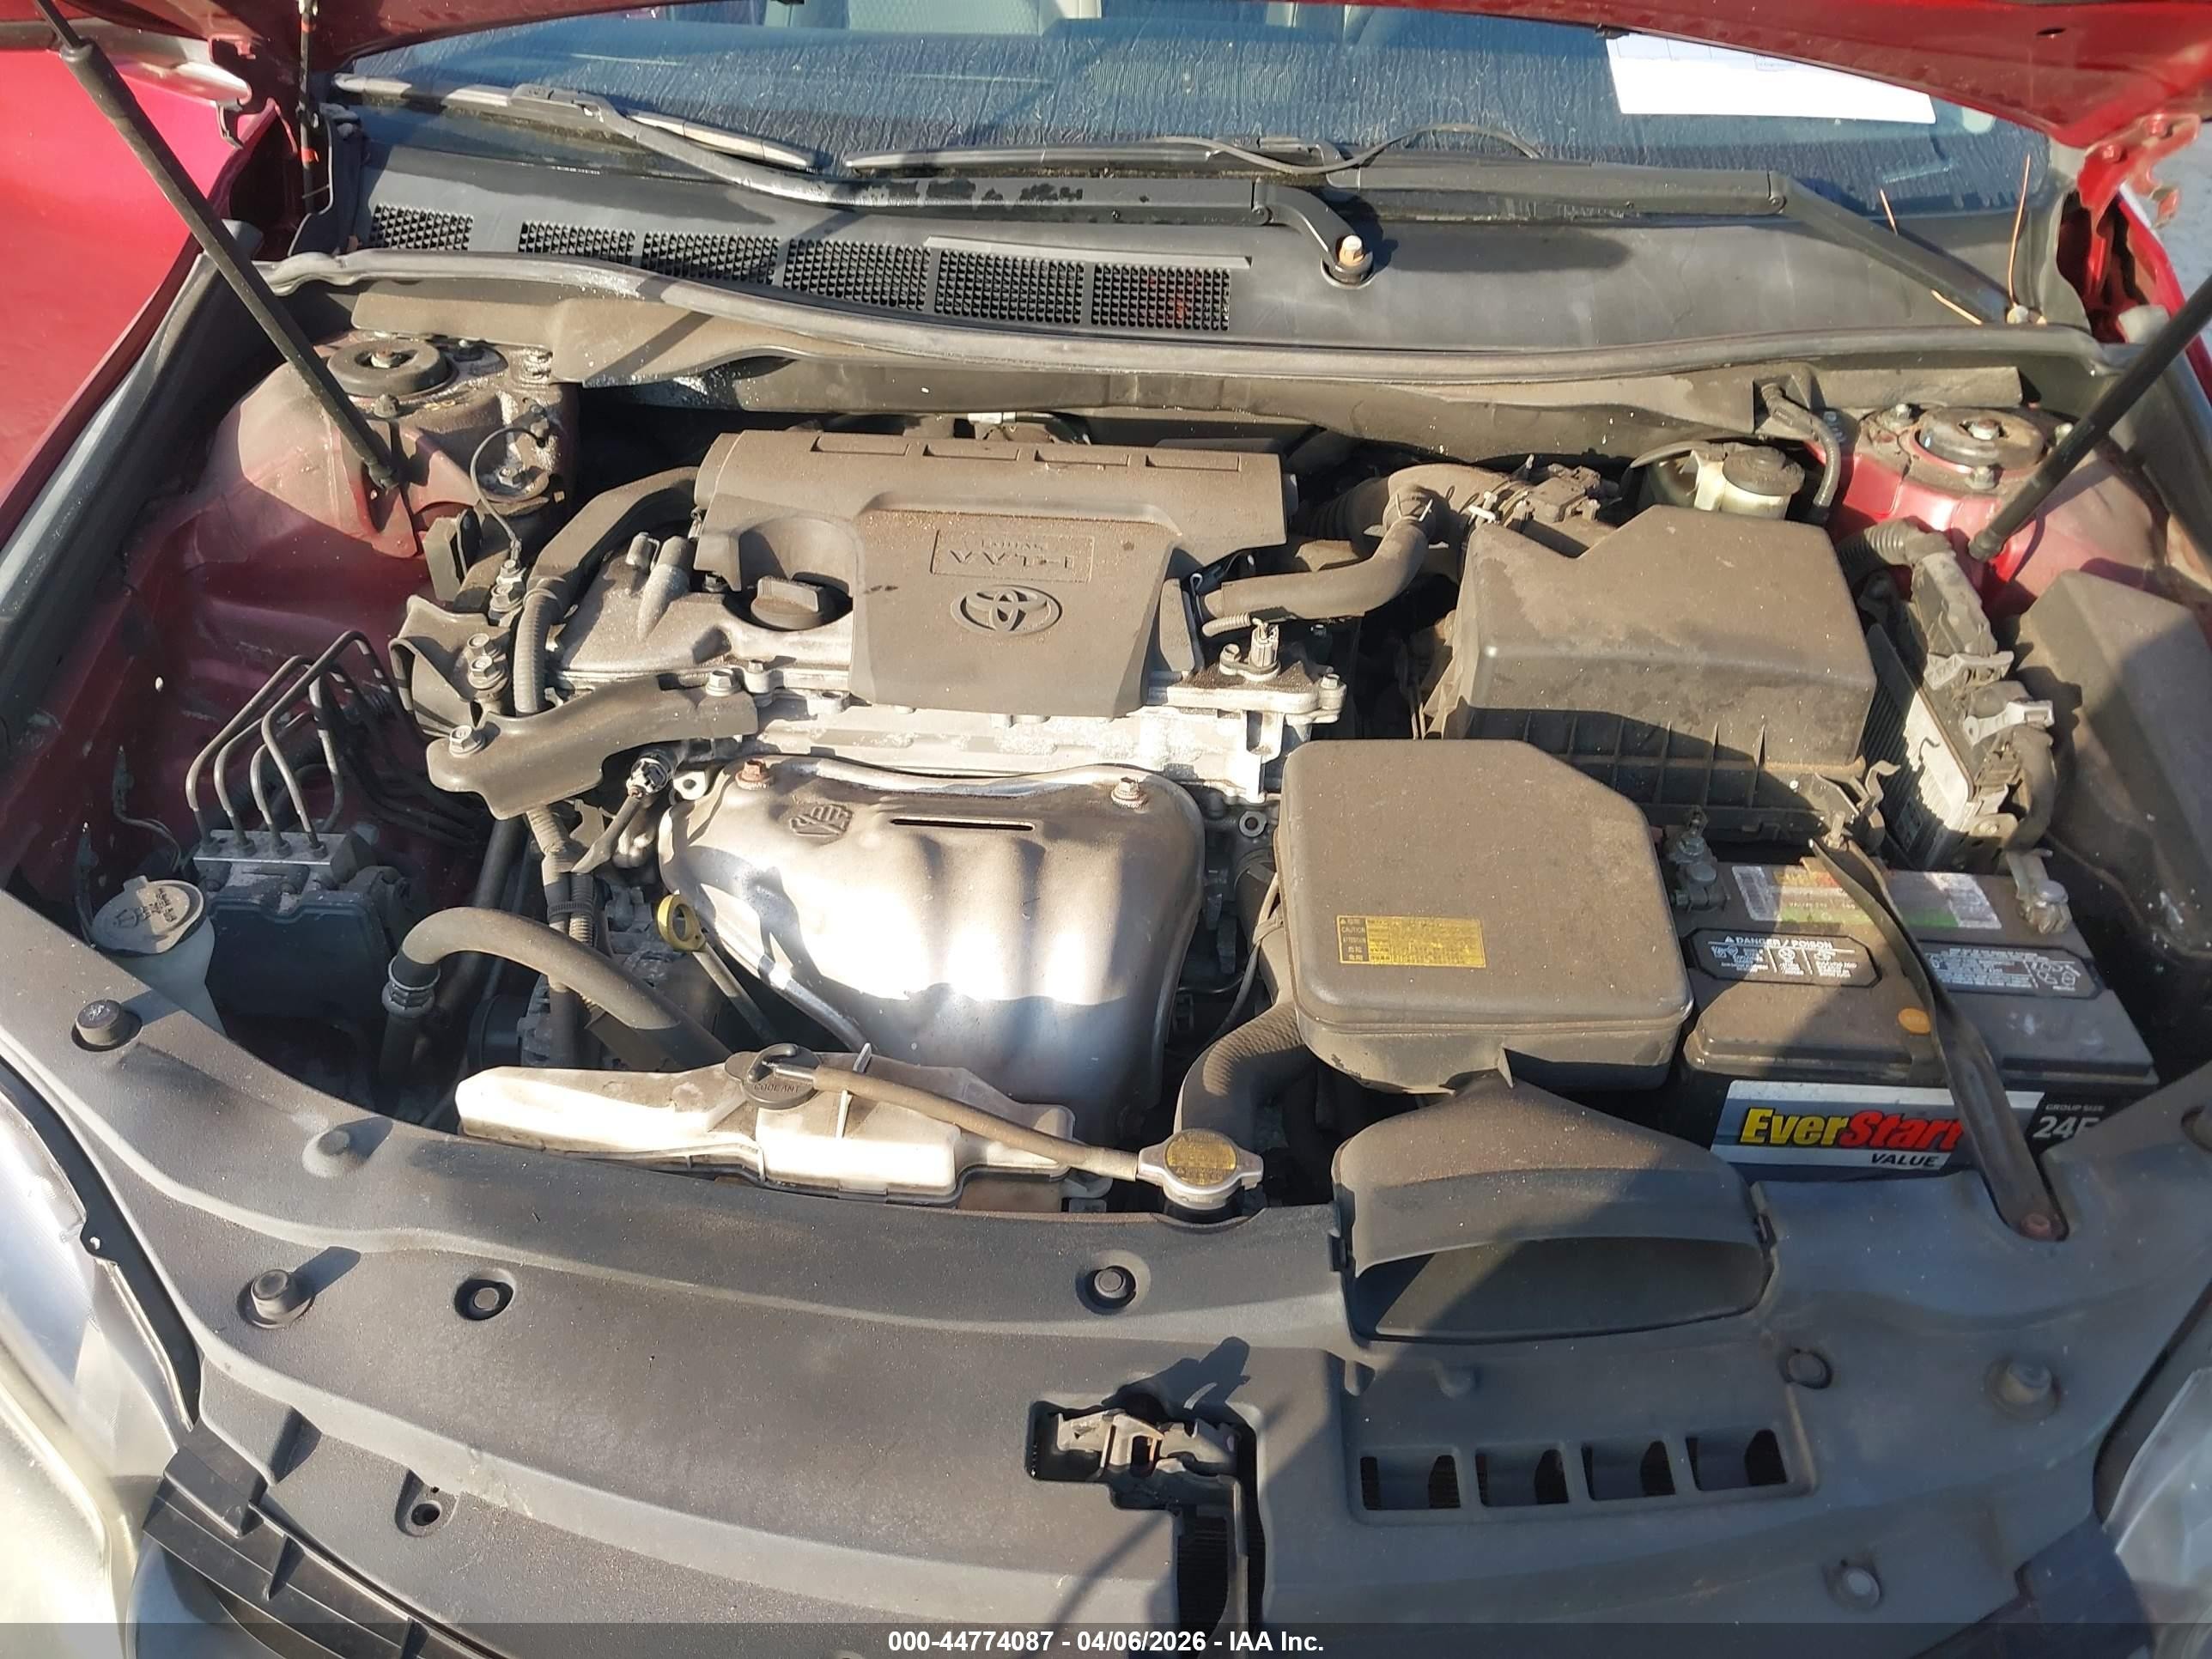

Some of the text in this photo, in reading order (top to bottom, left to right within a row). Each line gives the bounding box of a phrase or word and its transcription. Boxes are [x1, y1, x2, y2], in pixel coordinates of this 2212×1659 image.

[1735, 937, 1781, 948] DANGER
[1790, 939, 1833, 949] POISON
[754, 1084, 799, 1094] COOLANT
[1739, 1107, 1964, 1152] EverStart
[1871, 1152, 1939, 1167] VALUE
